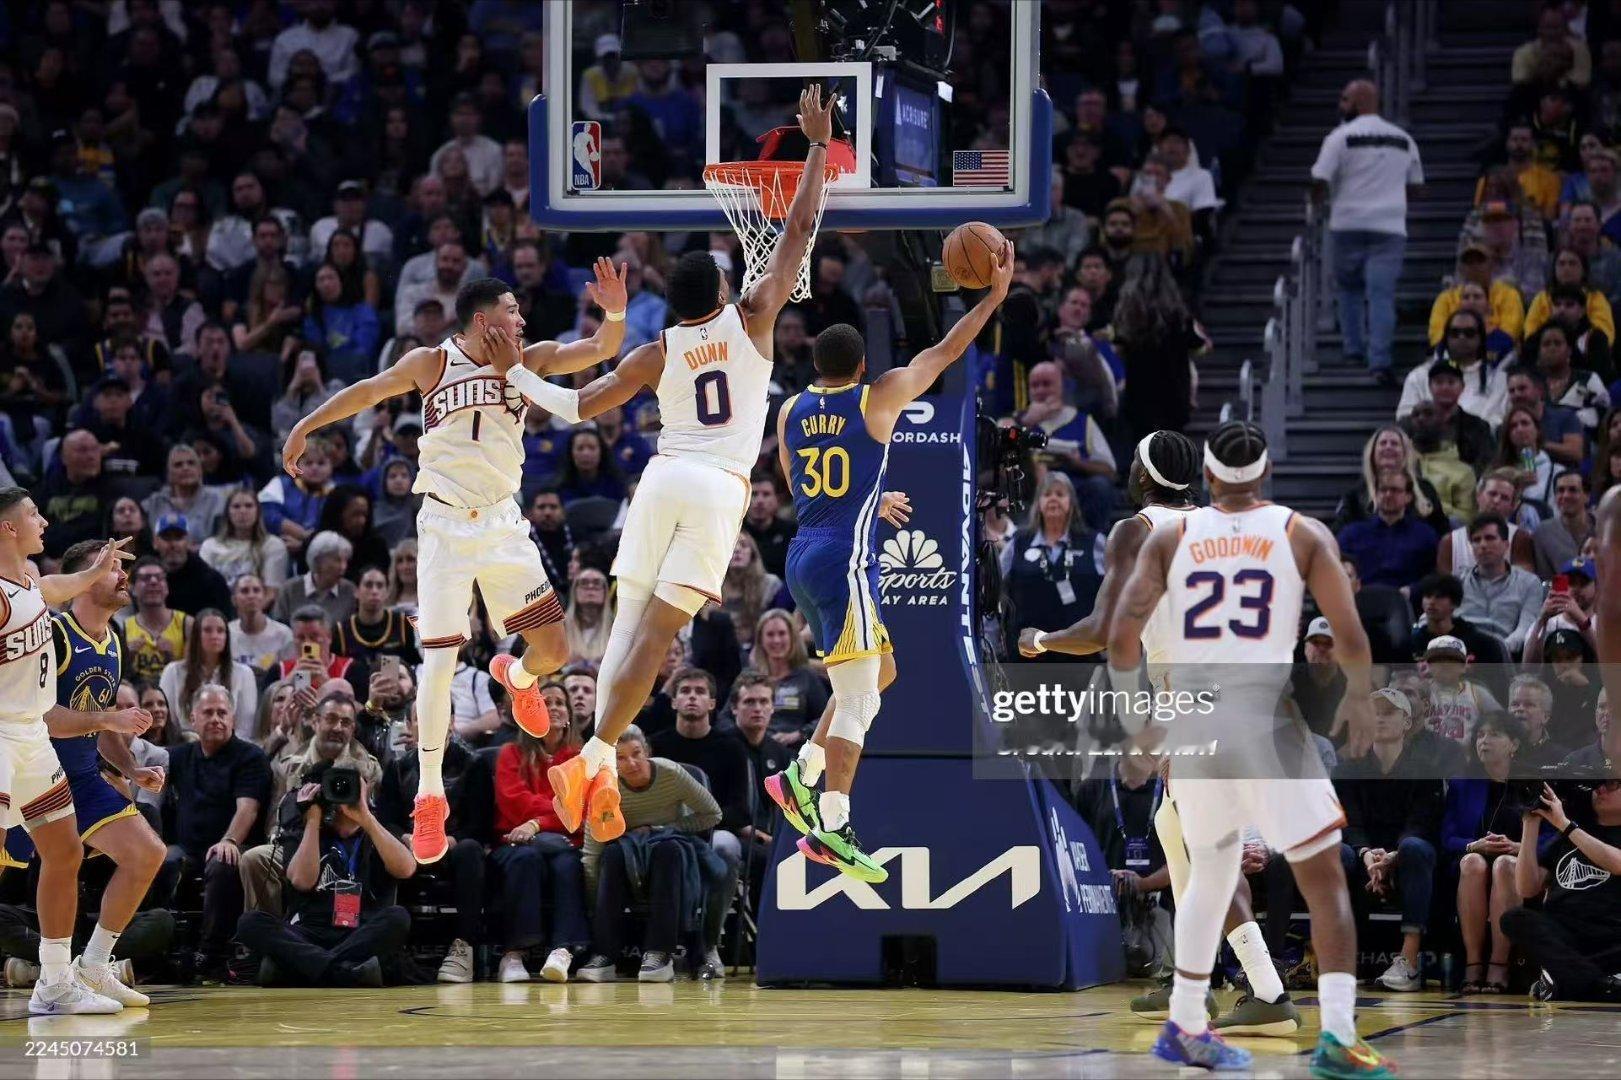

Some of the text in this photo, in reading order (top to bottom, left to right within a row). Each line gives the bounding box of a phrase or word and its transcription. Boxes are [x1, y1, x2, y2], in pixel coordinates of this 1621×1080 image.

[574, 174, 589, 186] NBA
[683, 341, 728, 371] DUNN
[694, 369, 733, 427] 0
[471, 410, 481, 441] 1
[801, 414, 846, 437] CURRY
[892, 431, 961, 444] ORDASH
[796, 446, 850, 498] 30
[1189, 537, 1275, 564] GOODWIN
[880, 595, 948, 606] AY AREA
[1184, 569, 1274, 640] 23
[39, 652, 48, 688] 8
[75, 666, 102, 683] GOLDEN
